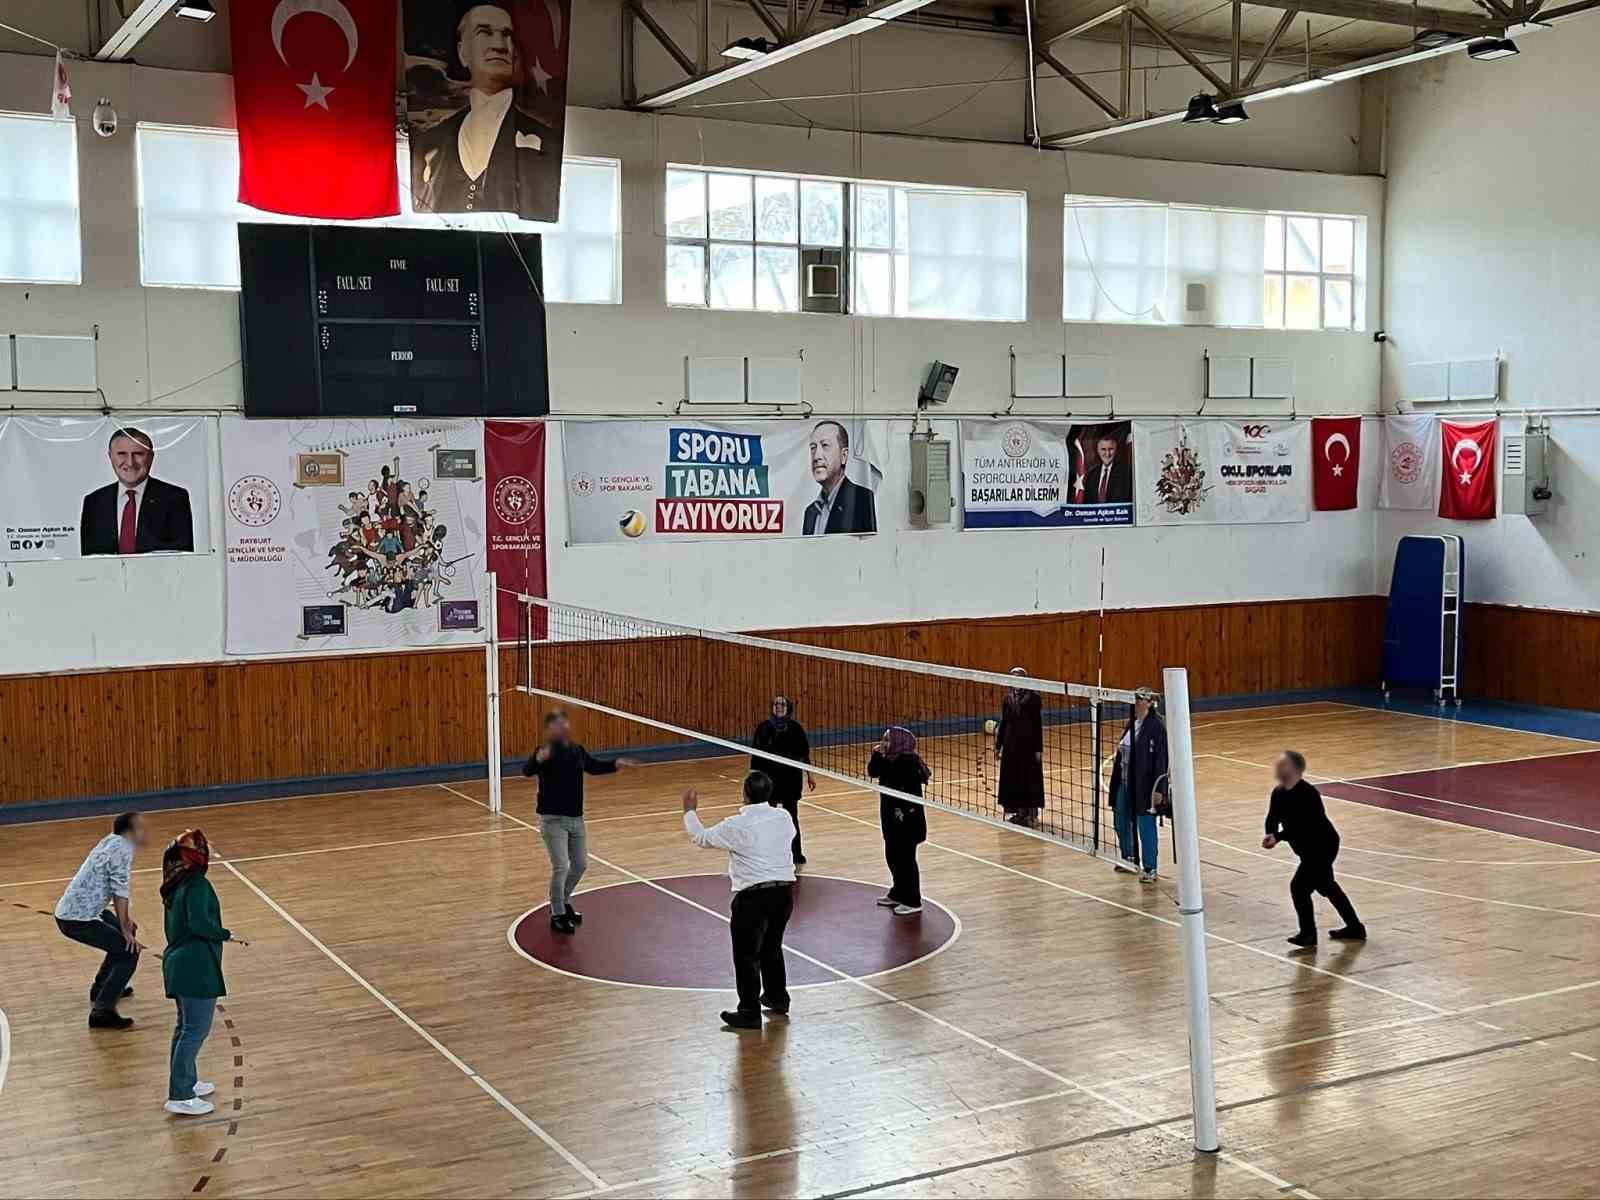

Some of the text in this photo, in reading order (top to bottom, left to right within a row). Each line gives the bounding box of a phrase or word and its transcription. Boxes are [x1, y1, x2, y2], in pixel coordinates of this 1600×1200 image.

[390, 259, 407, 270] TIME
[391, 351, 413, 361] PERIOD
[677, 432, 751, 464] SPORU
[998, 457, 1046, 468] ANTRENÖR
[1049, 458, 1061, 468] VE
[671, 468, 761, 497] TABANA
[972, 472, 1059, 484] SPORCULARIMIZA
[971, 485, 1060, 504] BAŞARILAR DİLERİM
[659, 503, 781, 530] YAYIYORUZ
